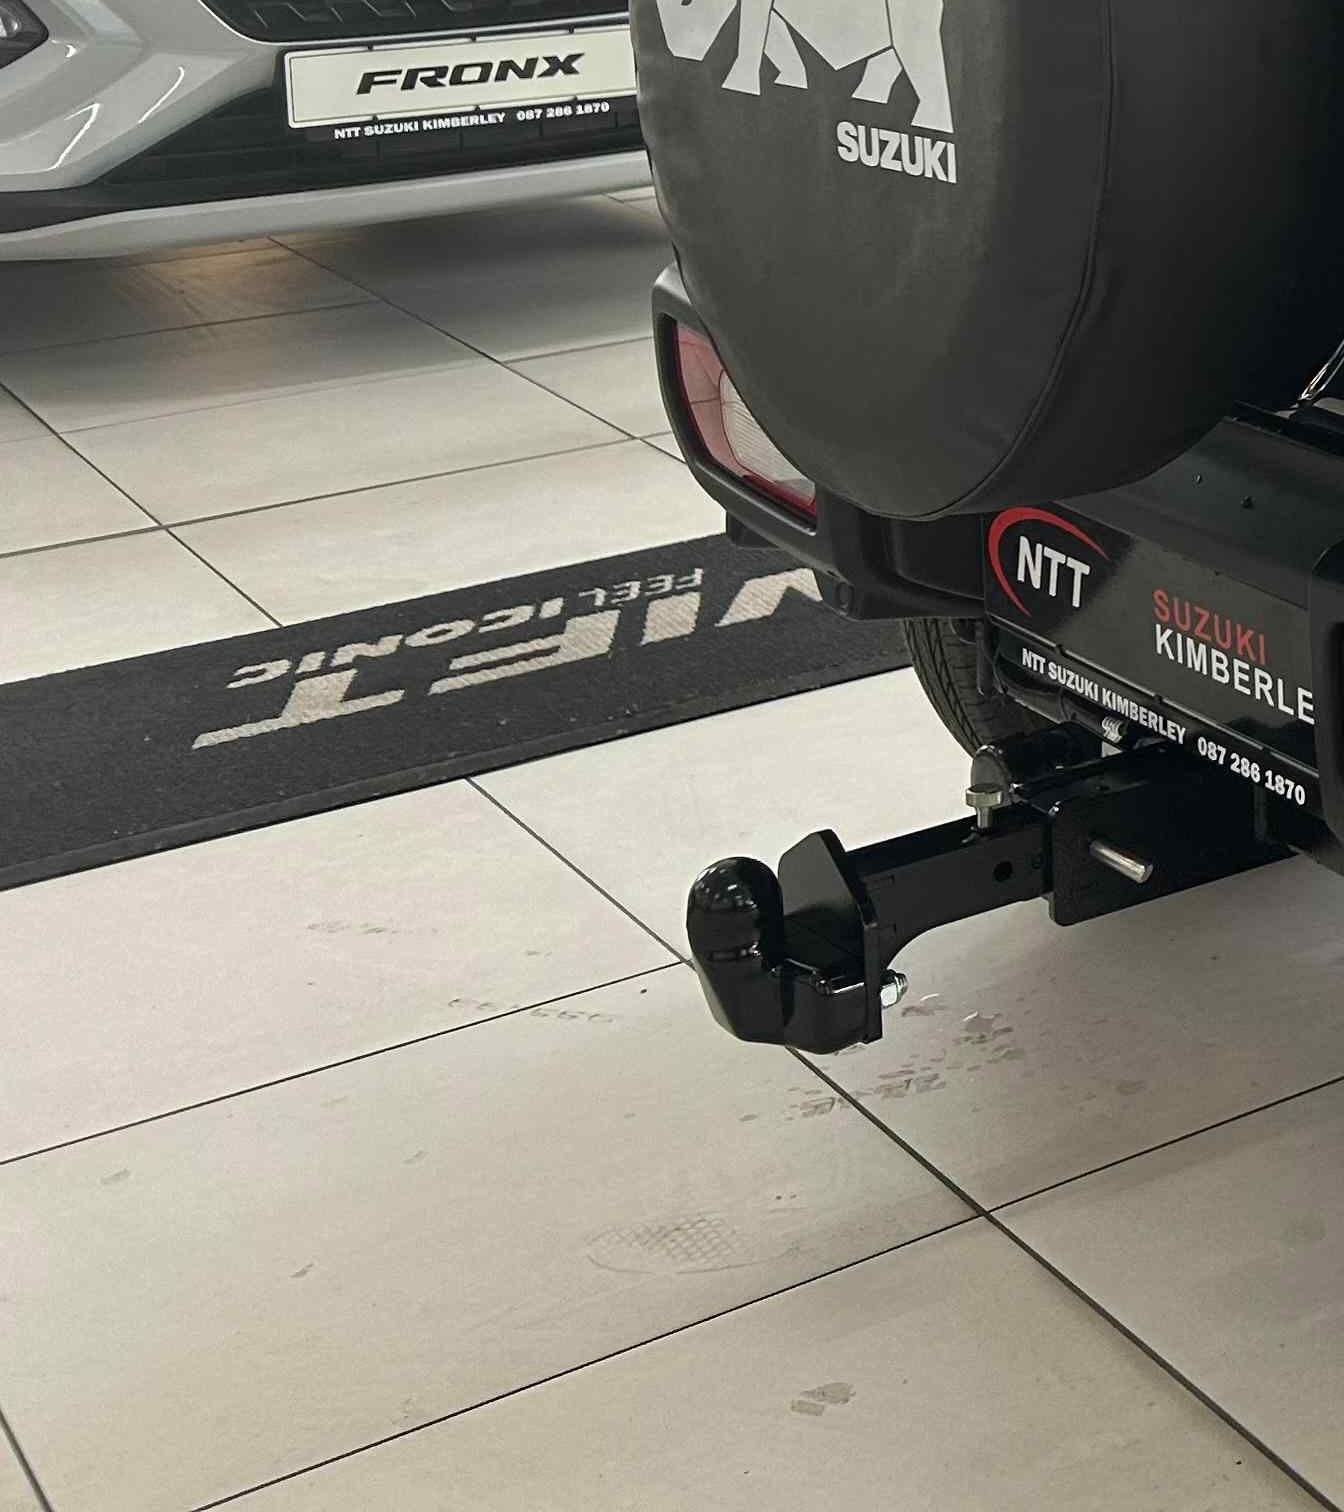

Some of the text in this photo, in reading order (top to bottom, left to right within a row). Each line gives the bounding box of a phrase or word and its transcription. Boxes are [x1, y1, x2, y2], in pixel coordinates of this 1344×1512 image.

[355, 51, 586, 96] FRONX
[334, 127, 361, 140] NTT
[364, 120, 419, 137] SUZUKI
[422, 111, 506, 130] KIMBERLEY
[516, 108, 542, 122] 087
[576, 101, 610, 116] 1870
[836, 120, 958, 184] SUZUKI
[1016, 535, 1091, 608] NTT
[226, 568, 704, 689] FEEL ICONIC
[1152, 588, 1266, 665] SUZUKI
[1154, 623, 1316, 725] KIMBERLE
[1021, 647, 1306, 806] NTT SUZUKI KIMBERLEY 087 286 1870
